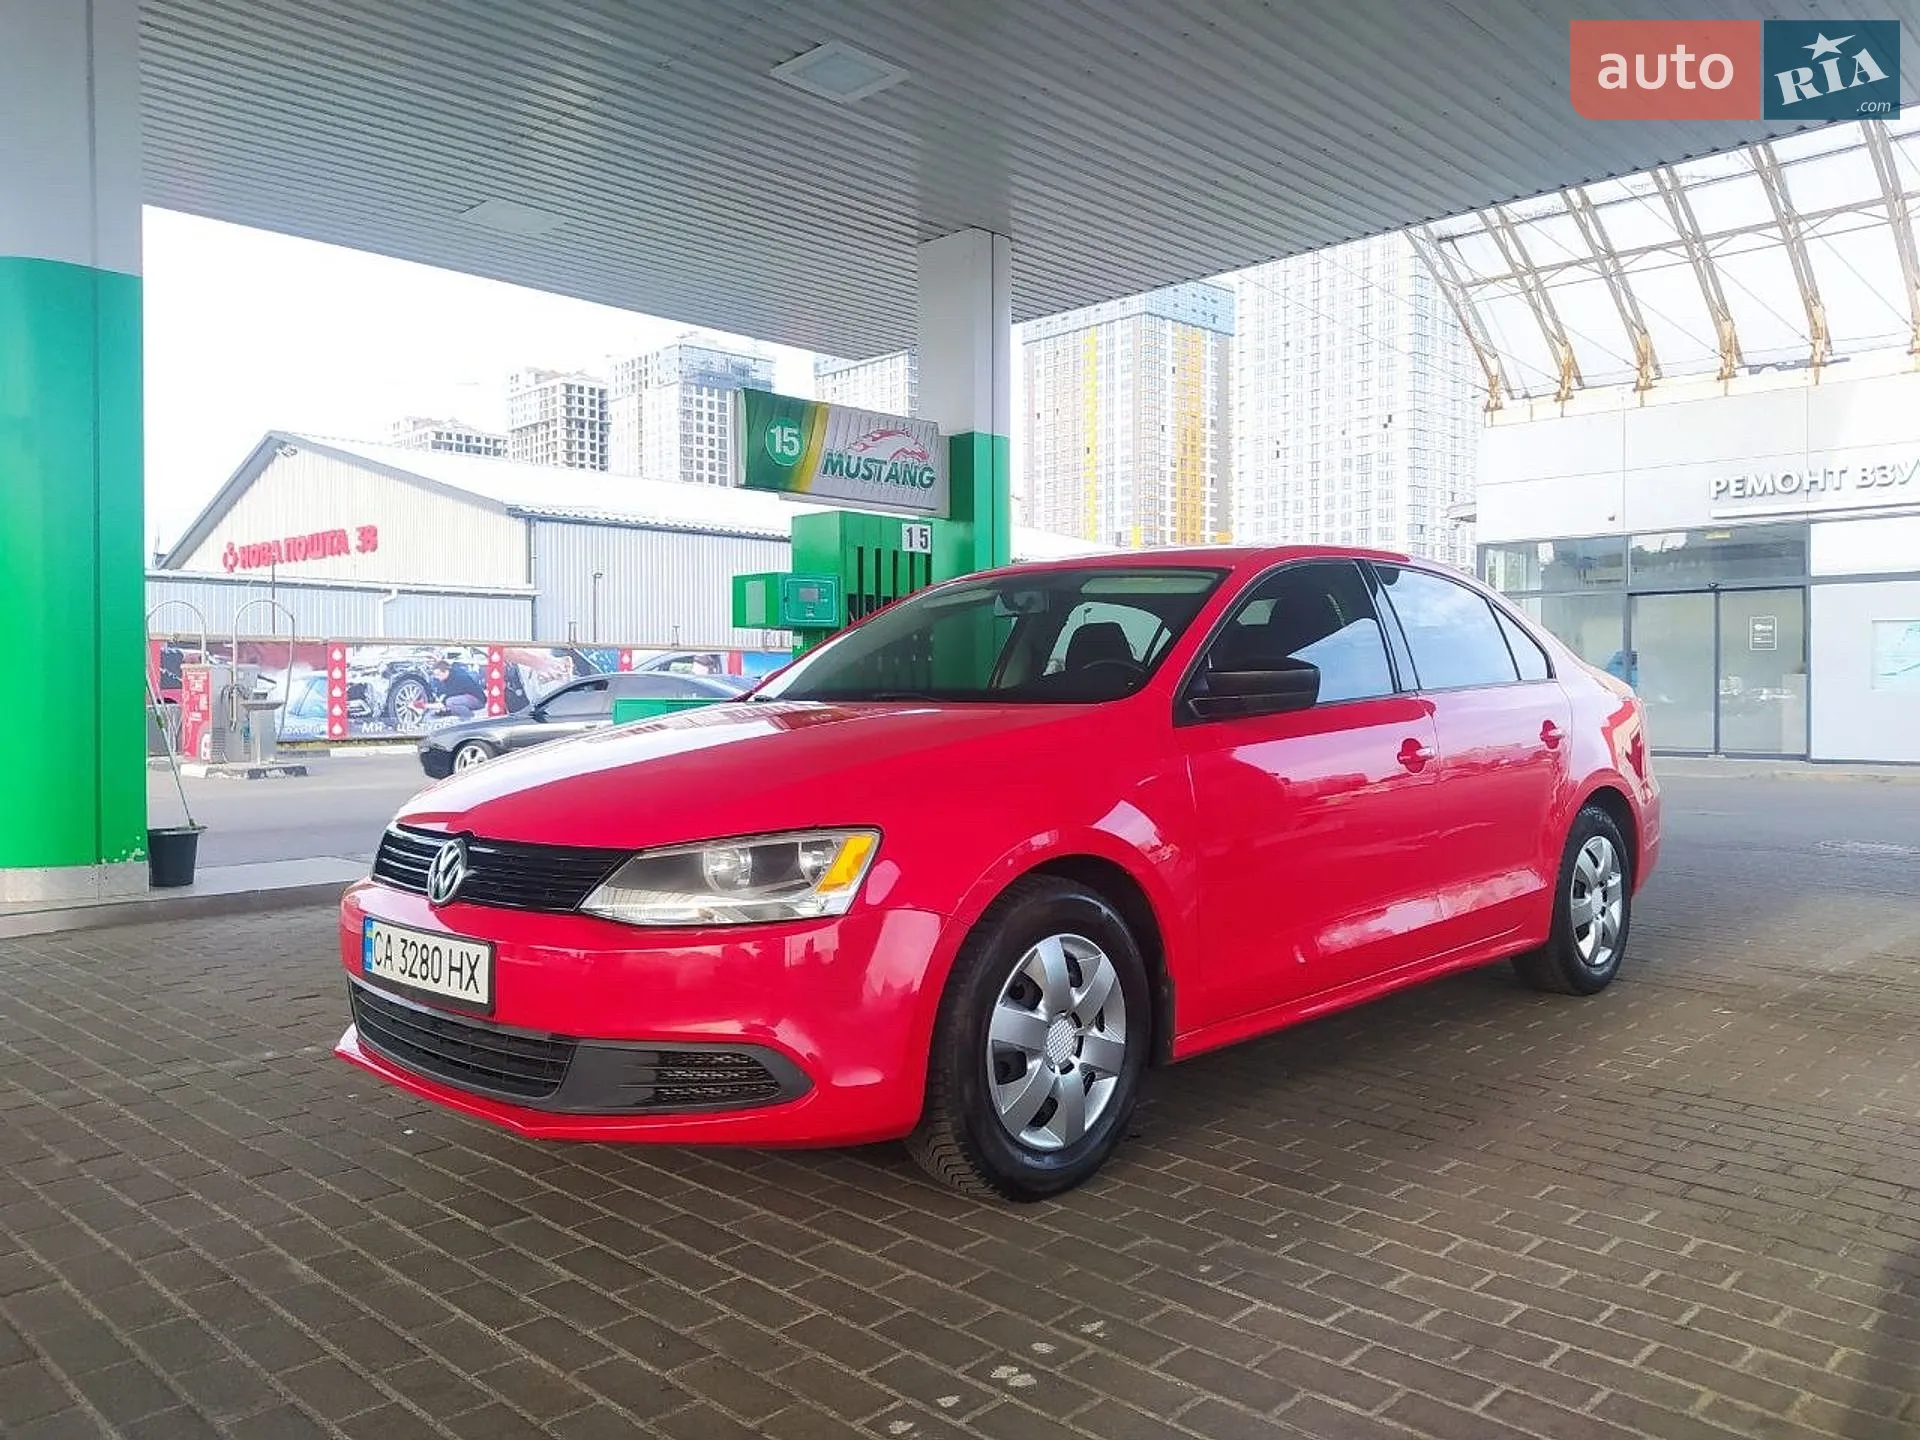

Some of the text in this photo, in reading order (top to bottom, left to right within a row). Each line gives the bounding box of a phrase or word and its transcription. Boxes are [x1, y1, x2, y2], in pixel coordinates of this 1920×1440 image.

[770, 424, 801, 457] 15
[821, 451, 936, 490] MUSTANG
[1709, 466, 1848, 501] РЕМОНТ
[239, 540, 285, 569] НОВА
[284, 529, 351, 562] ПОШТА
[905, 526, 930, 550] 15
[373, 930, 481, 995] CA 3280 HX
